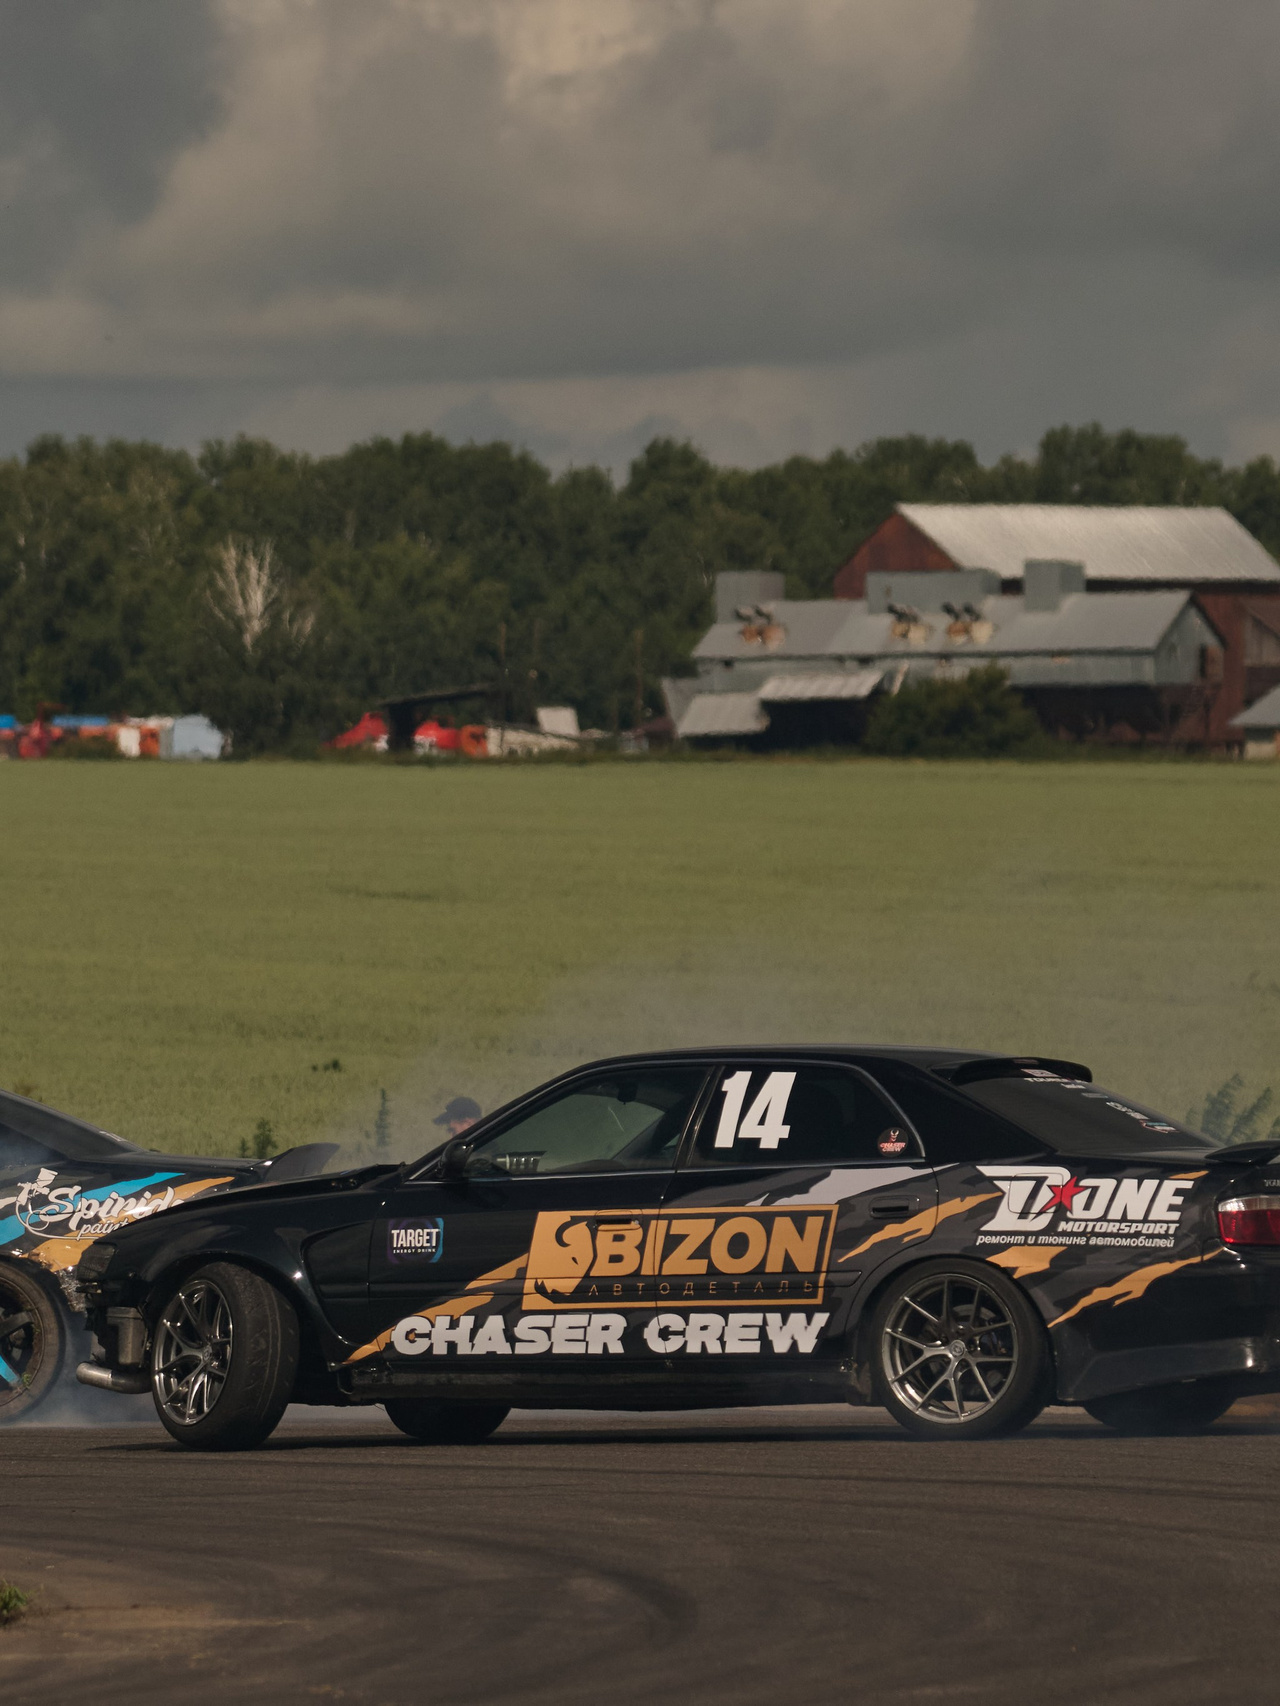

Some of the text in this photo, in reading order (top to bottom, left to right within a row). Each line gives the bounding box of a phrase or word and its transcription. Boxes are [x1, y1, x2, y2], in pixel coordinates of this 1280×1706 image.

[714, 1071, 797, 1149] 14
[39, 1185, 185, 1231] Spirid
[391, 1228, 439, 1248] TARGET
[976, 1235, 1175, 1248] ремонт и тюнинг автомобилей
[1058, 1221, 1180, 1235] MOTORSPORT
[590, 1216, 825, 1277] BIZON
[588, 1280, 814, 1297] АВТОДЕТАЛЬ
[391, 1312, 831, 1356] CHASER CREW
